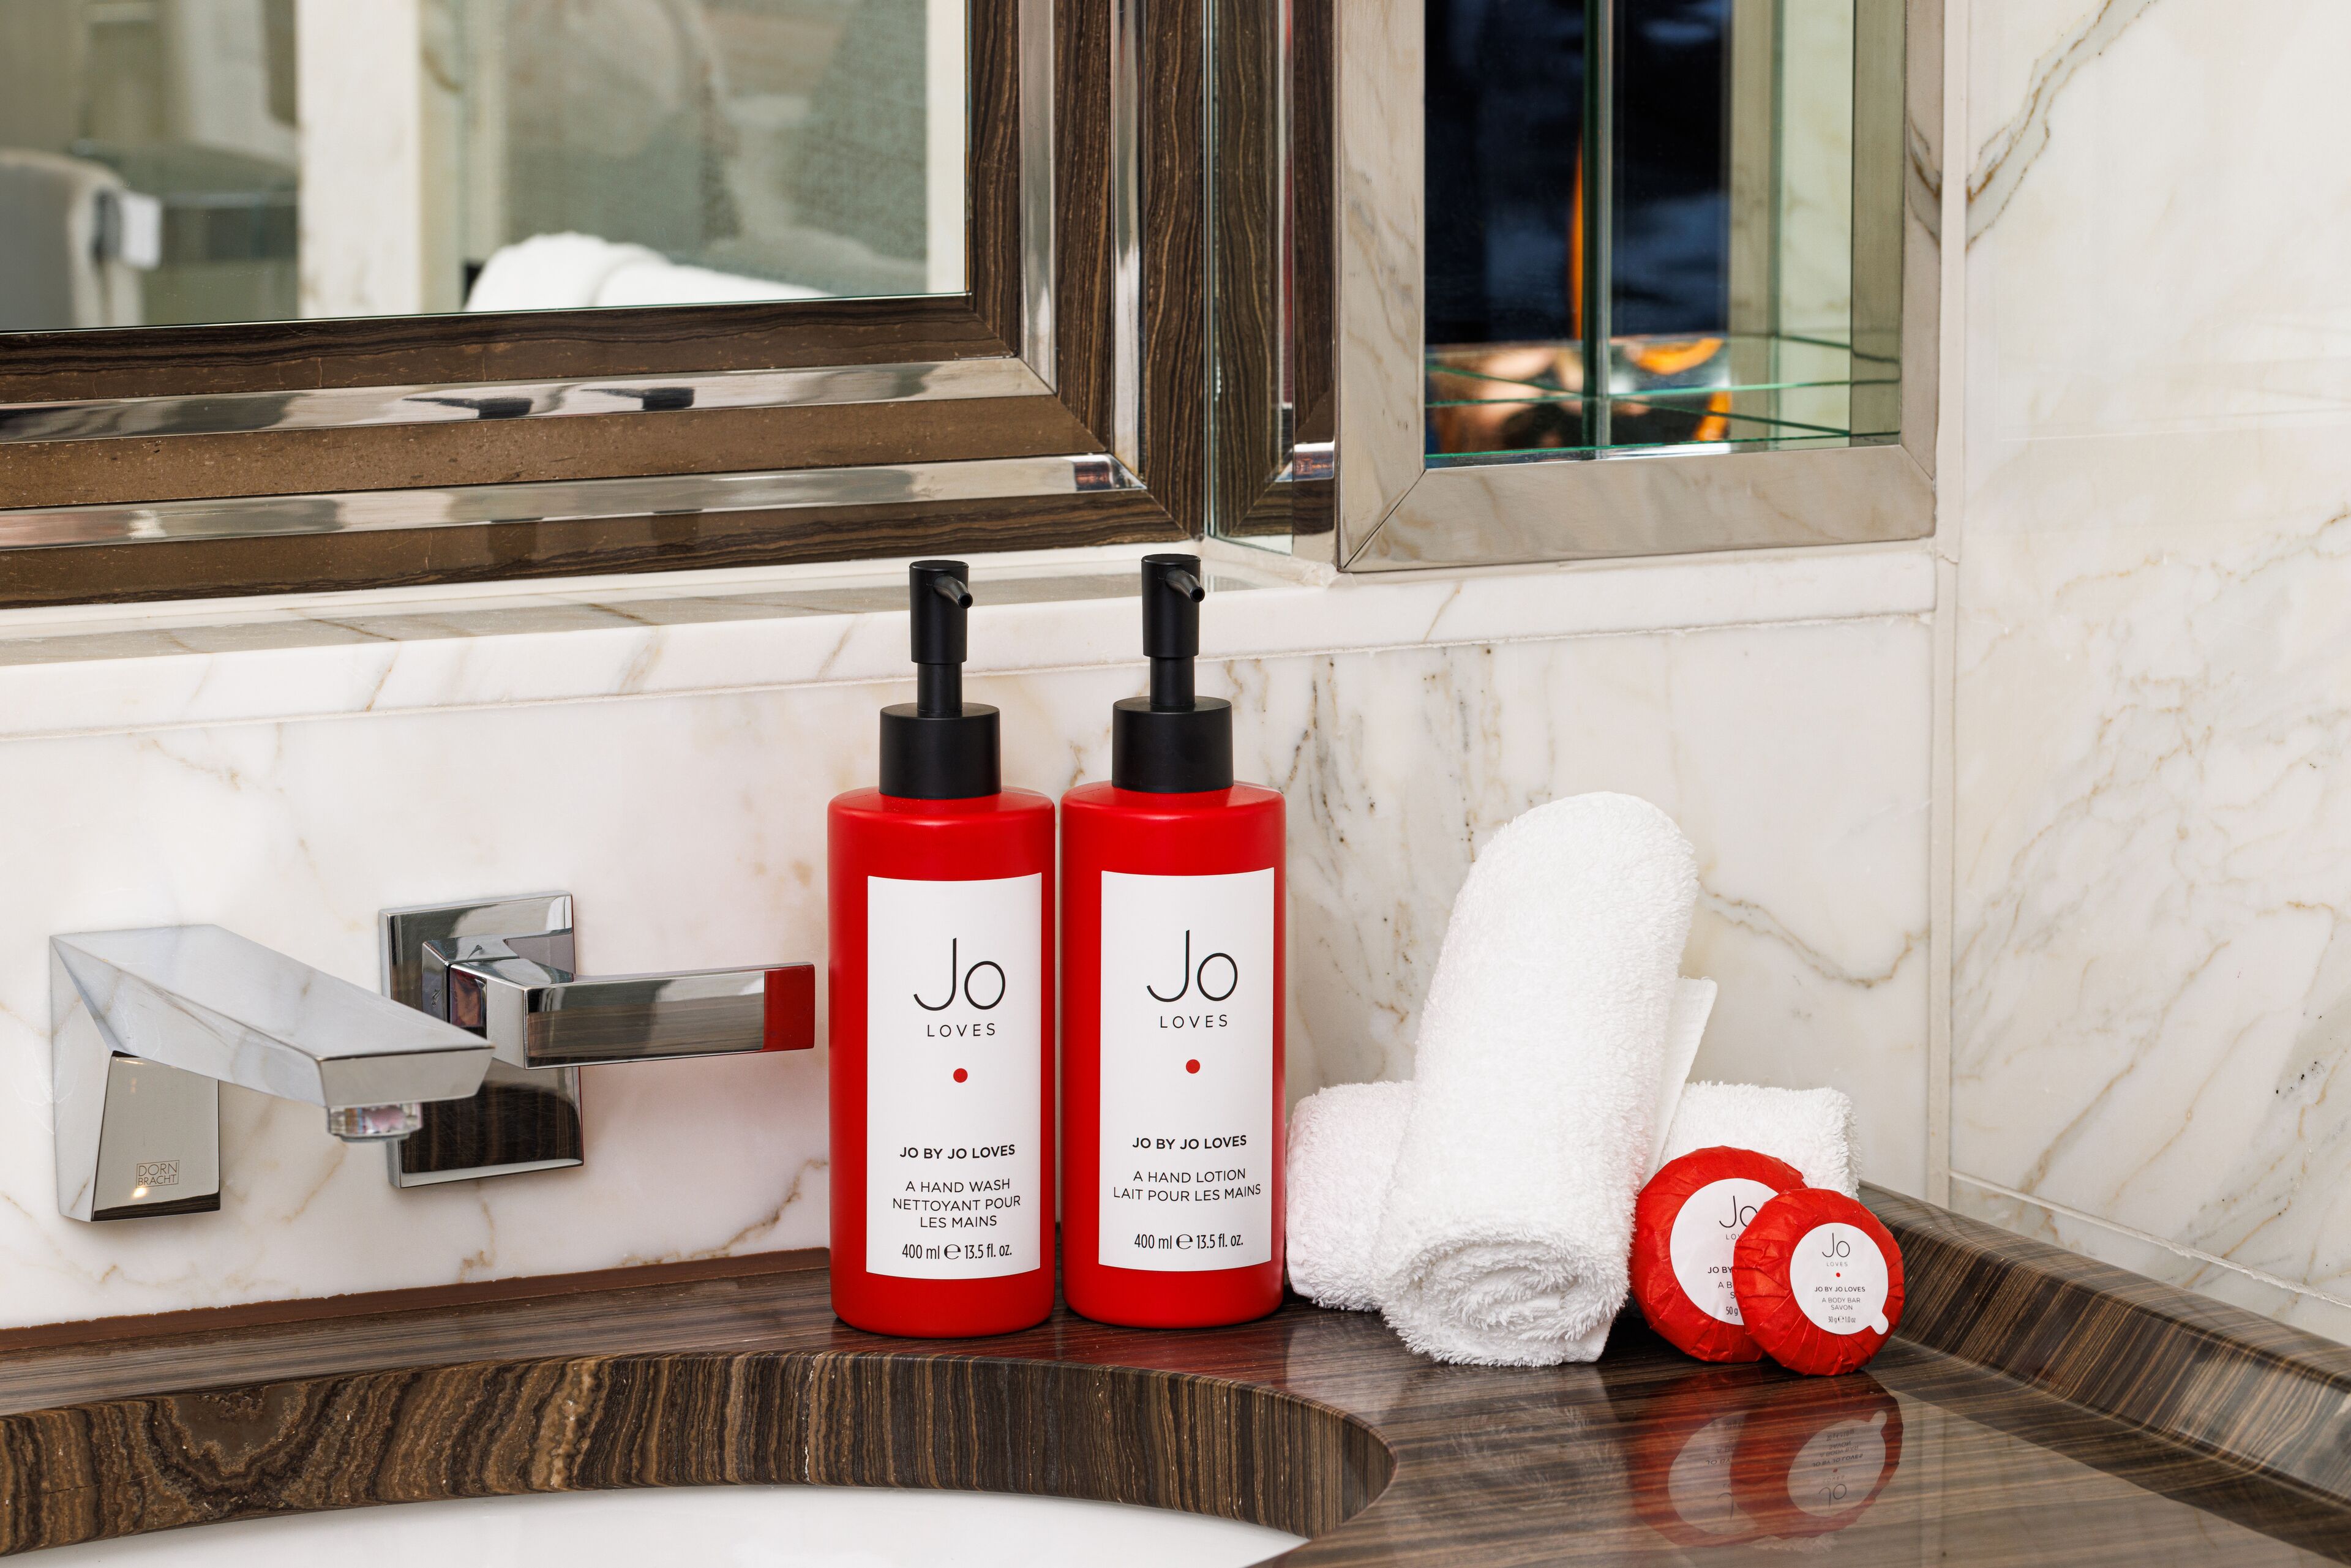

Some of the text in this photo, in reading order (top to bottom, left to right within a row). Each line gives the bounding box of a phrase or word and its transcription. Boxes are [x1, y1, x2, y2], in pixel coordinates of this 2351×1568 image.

[913, 937, 1006, 1011] Jo
[1146, 929, 1239, 1003] Jo
[1160, 1014, 1228, 1029] LOVES
[927, 1022, 996, 1038] LOVES
[1132, 1135, 1247, 1150] JO BY JO LOVES
[899, 1144, 1015, 1160] JO BY JO LOVES
[138, 1162, 178, 1177] DORN
[1133, 1168, 1246, 1184] A HAND LOTION
[138, 1174, 177, 1186] BRACHT
[905, 1178, 1010, 1193] A HAND WASH
[1114, 1183, 1261, 1202] LAIT POUR LES MAINS
[893, 1195, 1021, 1212] NETTOYANT POUR
[920, 1215, 997, 1228] LES MAINS
[1134, 1233, 1155, 1249] 400
[1158, 1235, 1172, 1250] ml
[1196, 1234, 1216, 1250] 13.5
[1218, 1232, 1228, 1248] fl.
[1230, 1234, 1243, 1247] oz.
[1822, 1232, 1850, 1258] Jo
[902, 1244, 923, 1259] 400
[926, 1245, 940, 1259] ml
[964, 1244, 984, 1259] 13.5
[986, 1243, 996, 1258] fl.
[999, 1244, 1012, 1257] oz.
[1726, 1306, 1733, 1315] 50
